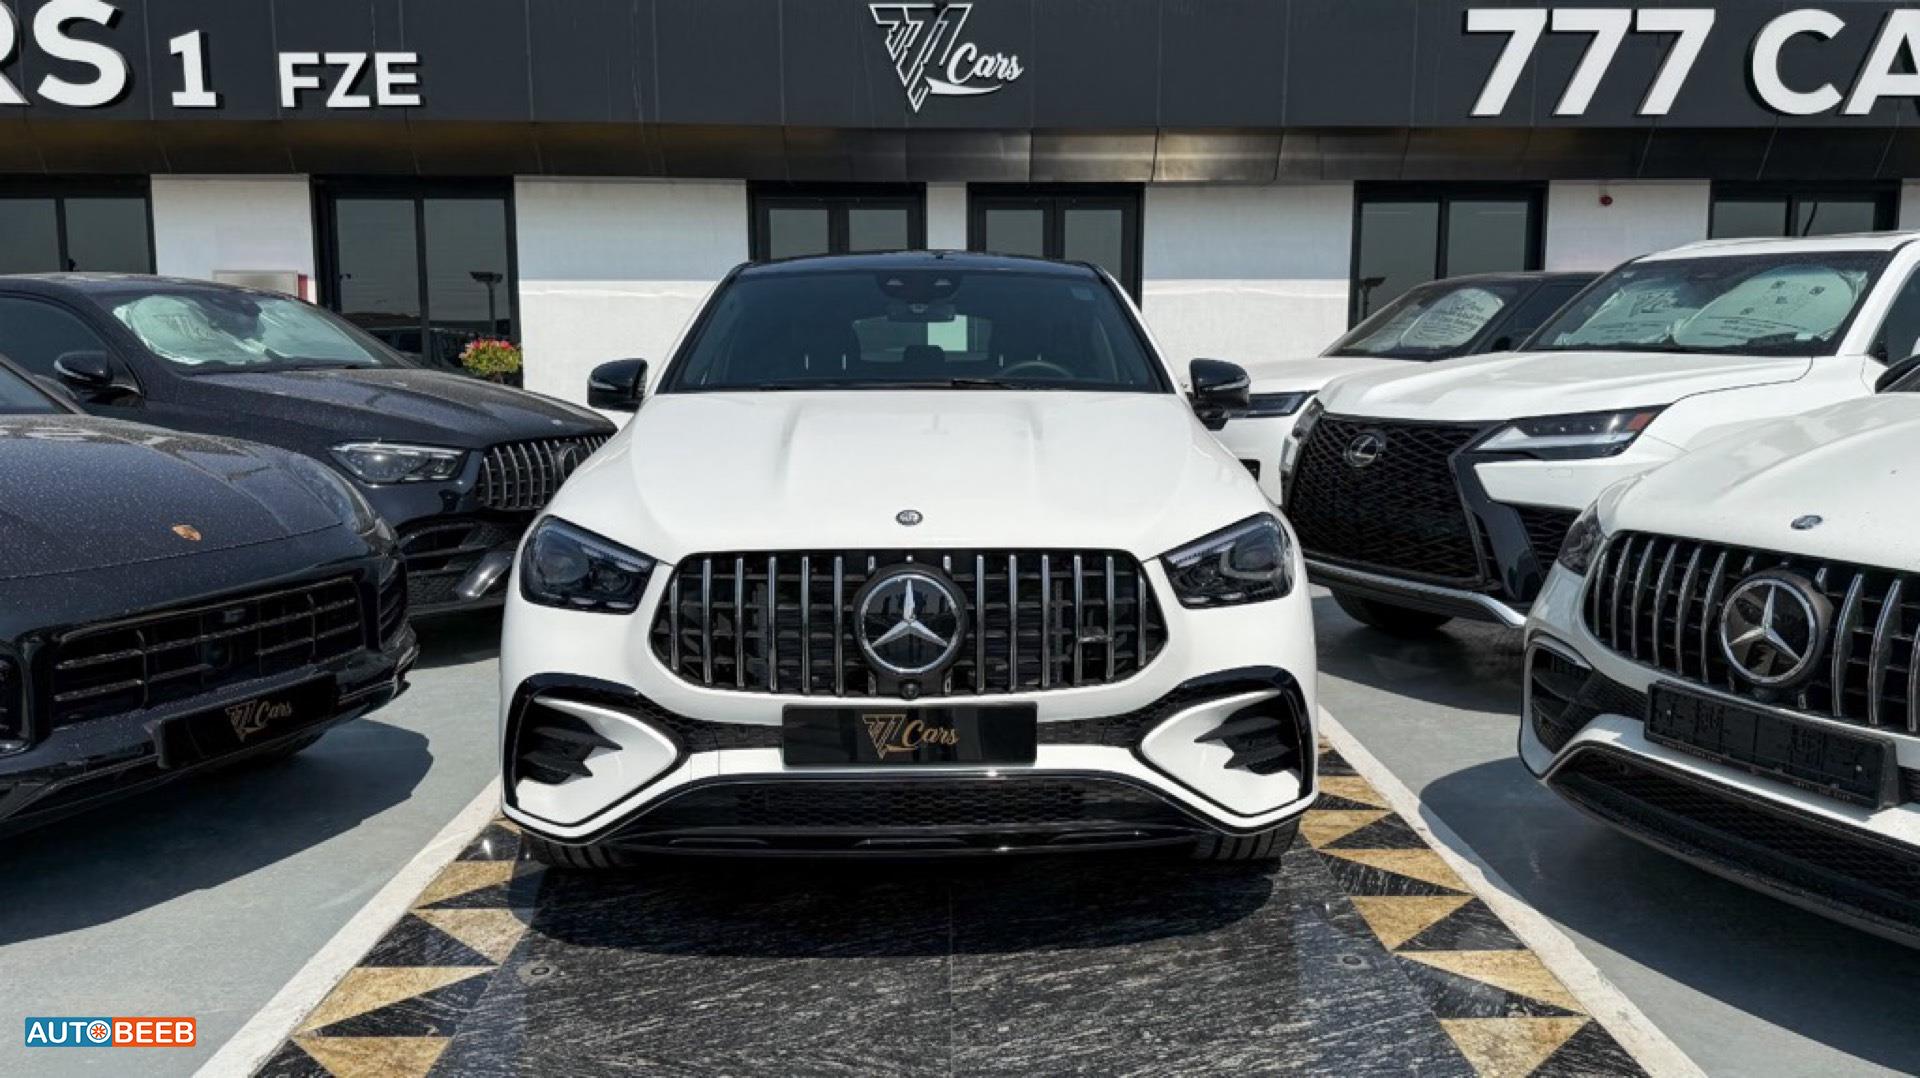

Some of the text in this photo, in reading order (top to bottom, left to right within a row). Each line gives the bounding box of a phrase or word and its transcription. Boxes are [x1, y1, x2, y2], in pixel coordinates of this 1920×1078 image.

[169, 29, 217, 107] 1
[278, 52, 421, 108] FZE
[946, 42, 1024, 85] Cars
[1466, 8, 1716, 116] 777
[902, 719, 960, 746] Cars
